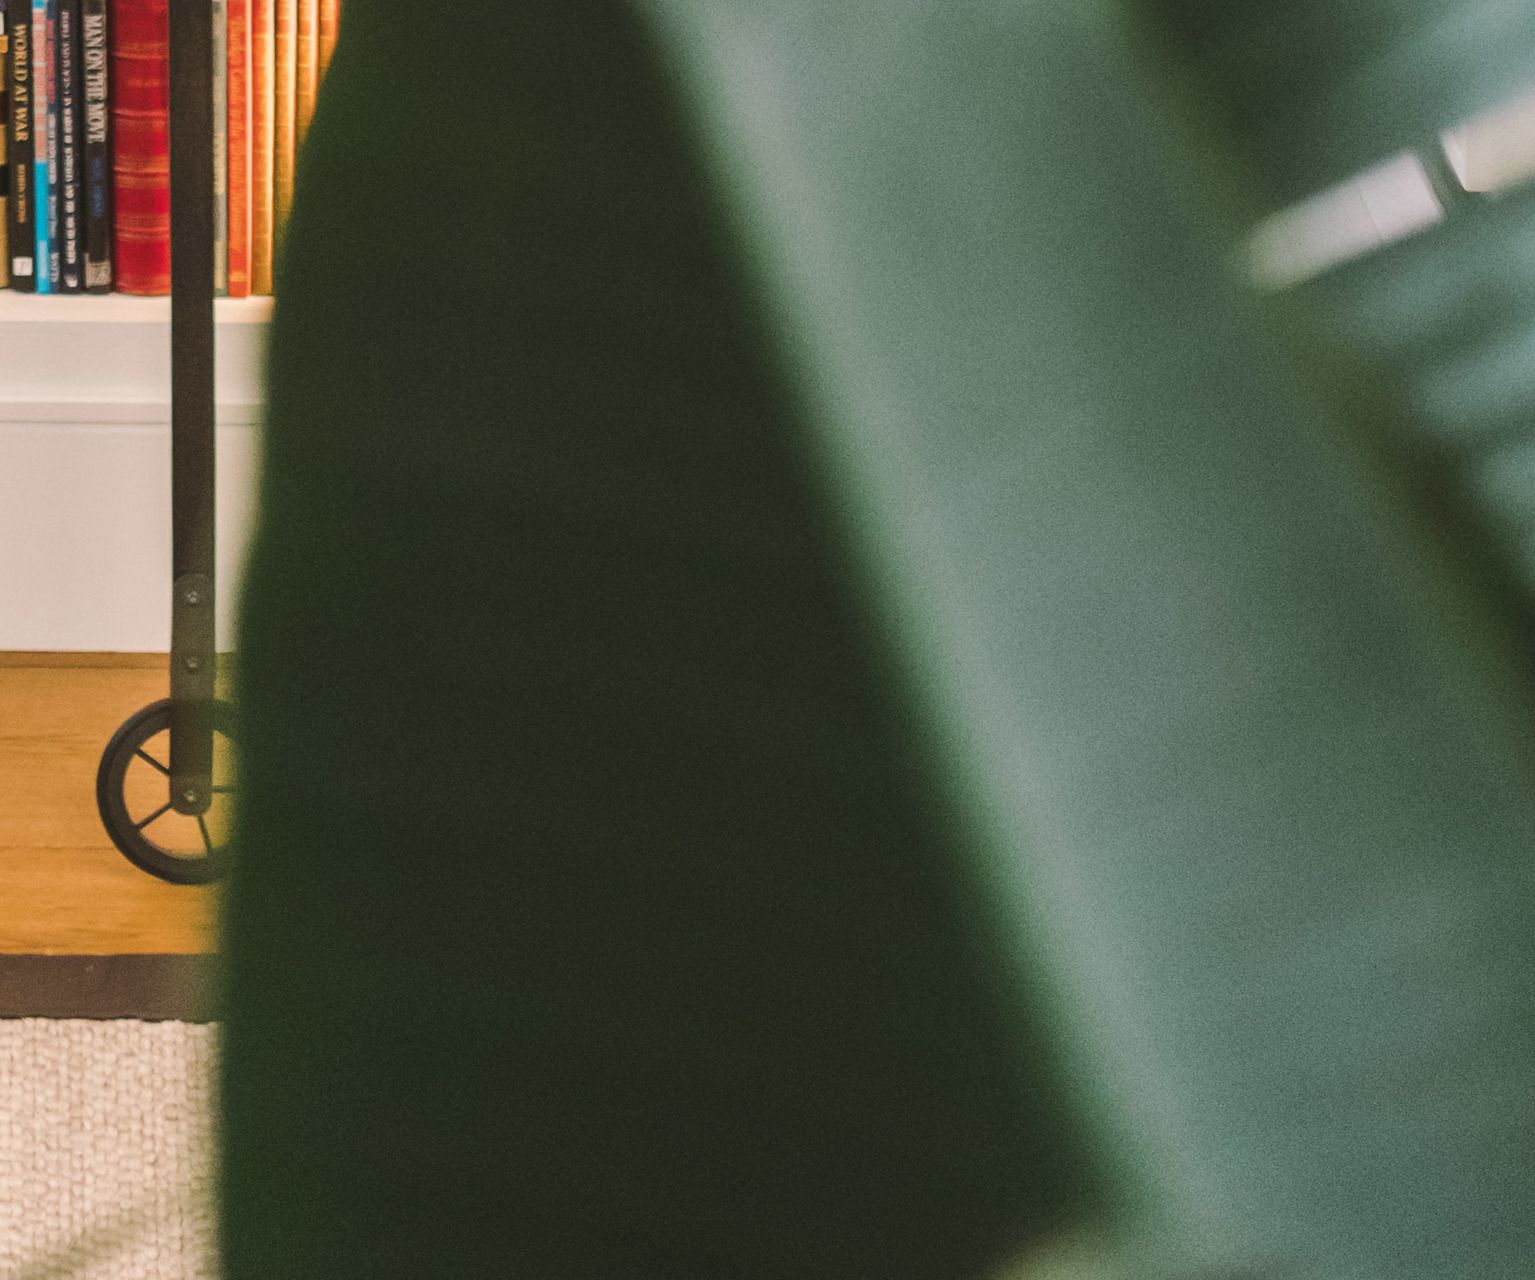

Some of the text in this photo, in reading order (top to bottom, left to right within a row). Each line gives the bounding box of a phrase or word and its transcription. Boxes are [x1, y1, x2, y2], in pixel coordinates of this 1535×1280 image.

[14, 24, 27, 142] WORLD AT WAR
[86, 15, 105, 144] MAN ON THE MOVE
